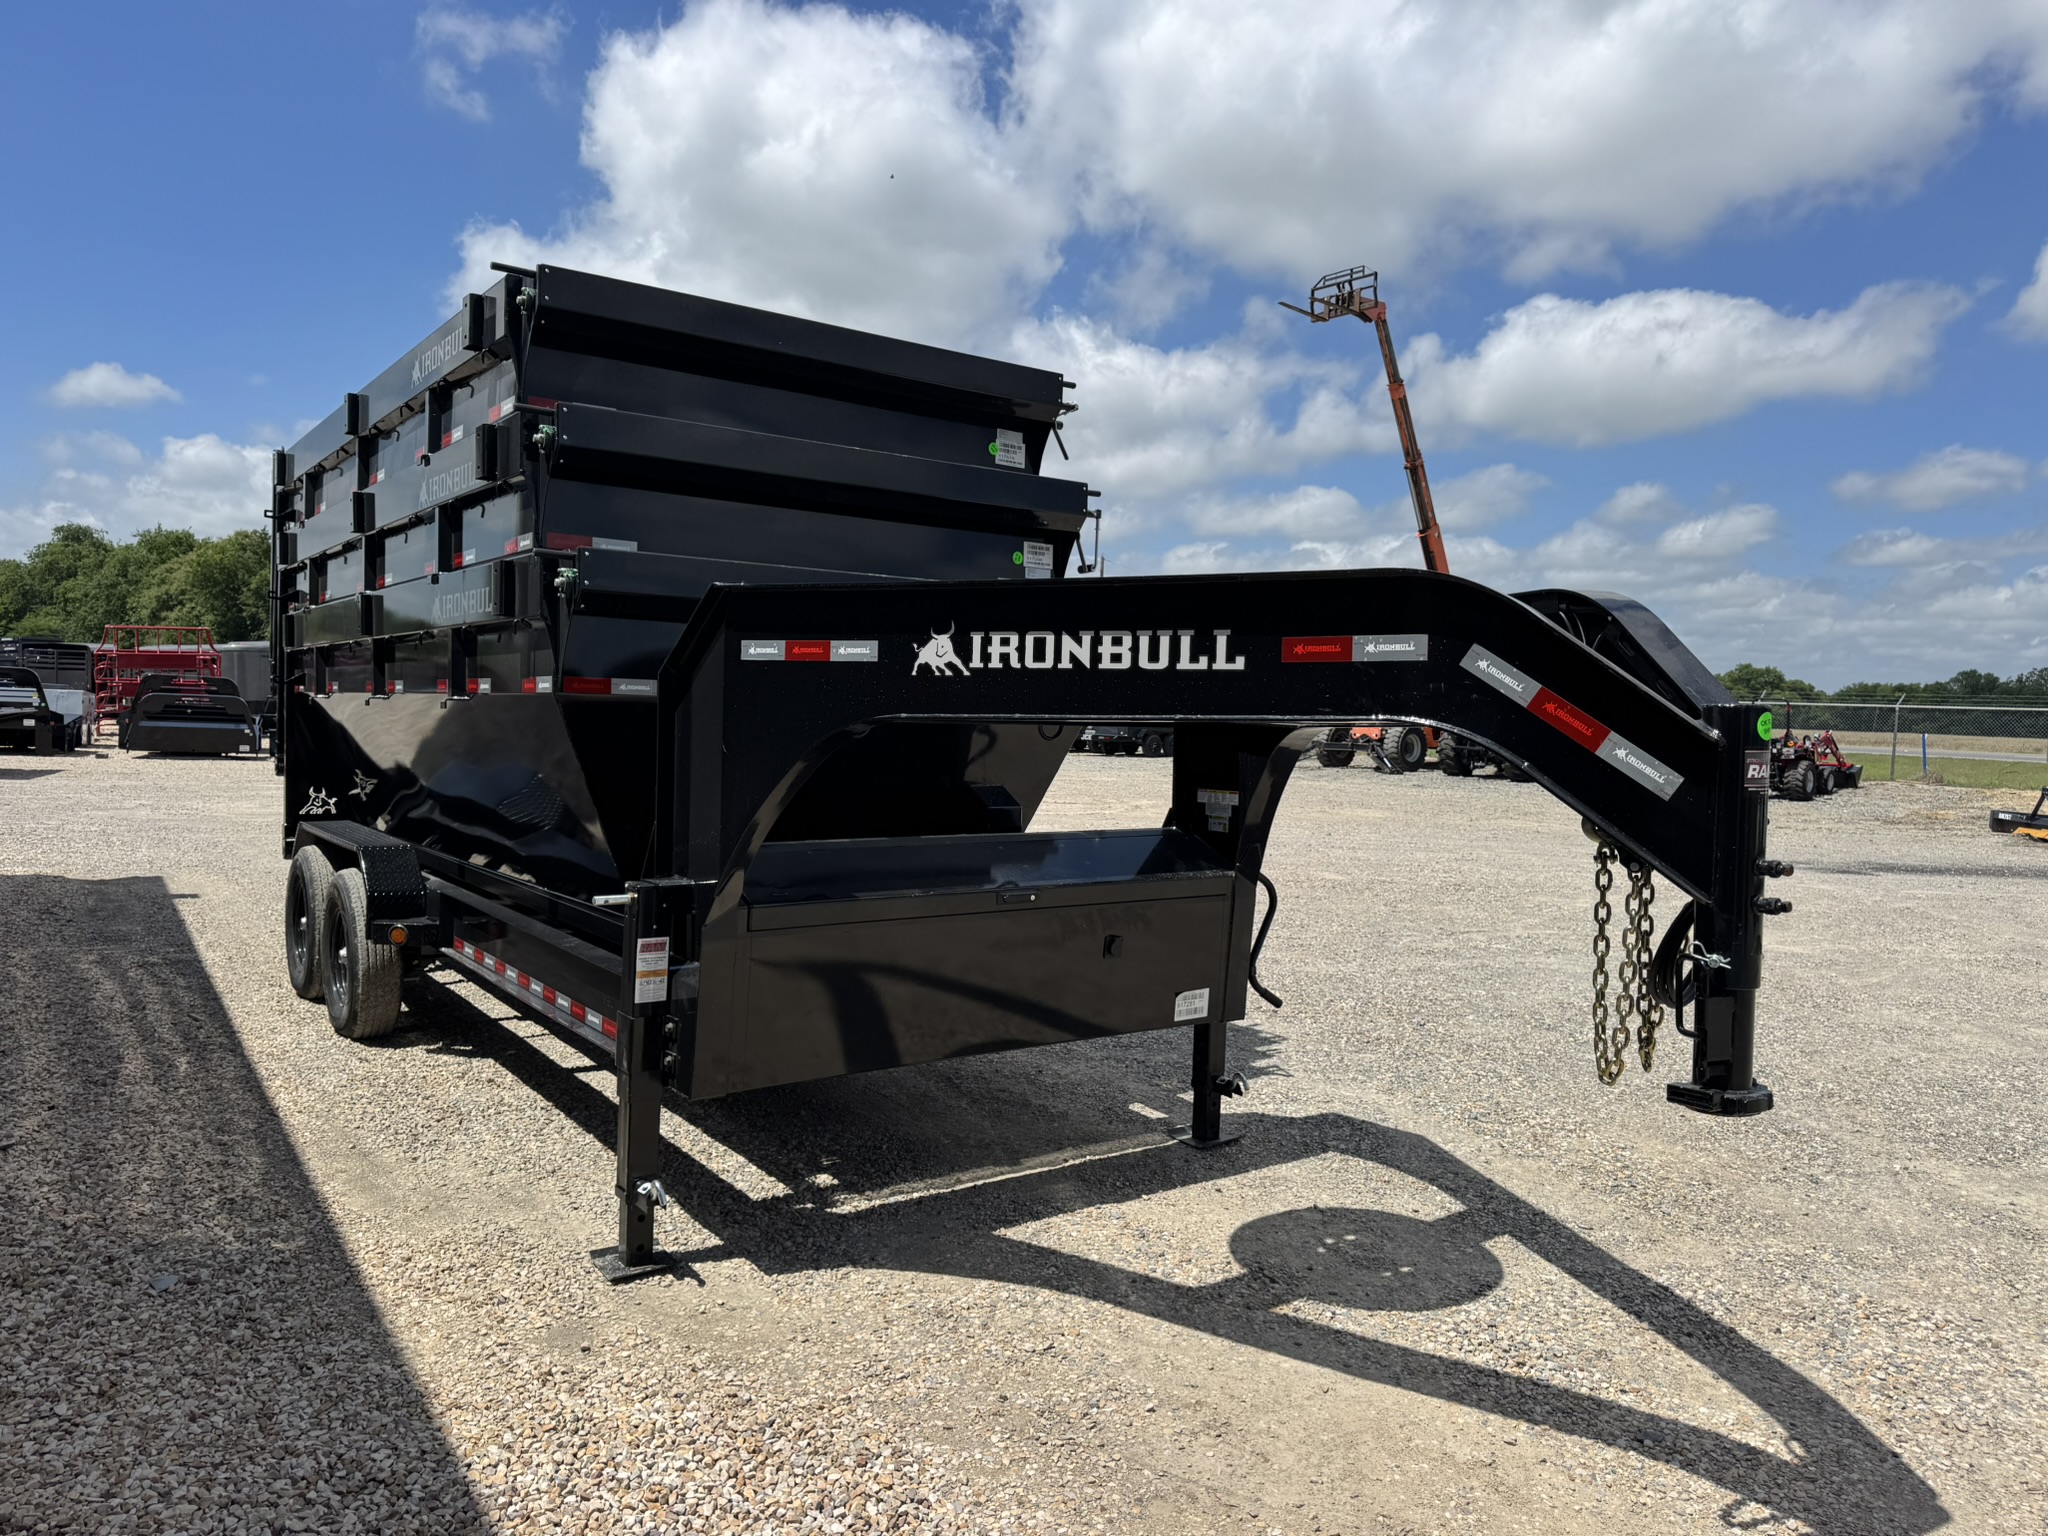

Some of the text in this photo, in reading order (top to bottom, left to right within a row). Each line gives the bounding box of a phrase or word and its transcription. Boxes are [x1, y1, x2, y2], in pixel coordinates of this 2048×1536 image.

[421, 326, 463, 378] IRONBUL
[429, 462, 475, 502] IRONBUL
[443, 587, 493, 619] IRONBUL
[969, 629, 1245, 669] IRONBULL
[1304, 644, 1341, 652] IRONBULL
[1376, 642, 1415, 651] IRONBULL
[1488, 665, 1524, 692] IRONBULL
[1555, 708, 1592, 736] IRONBULL
[1626, 754, 1665, 783] IRONBULL
